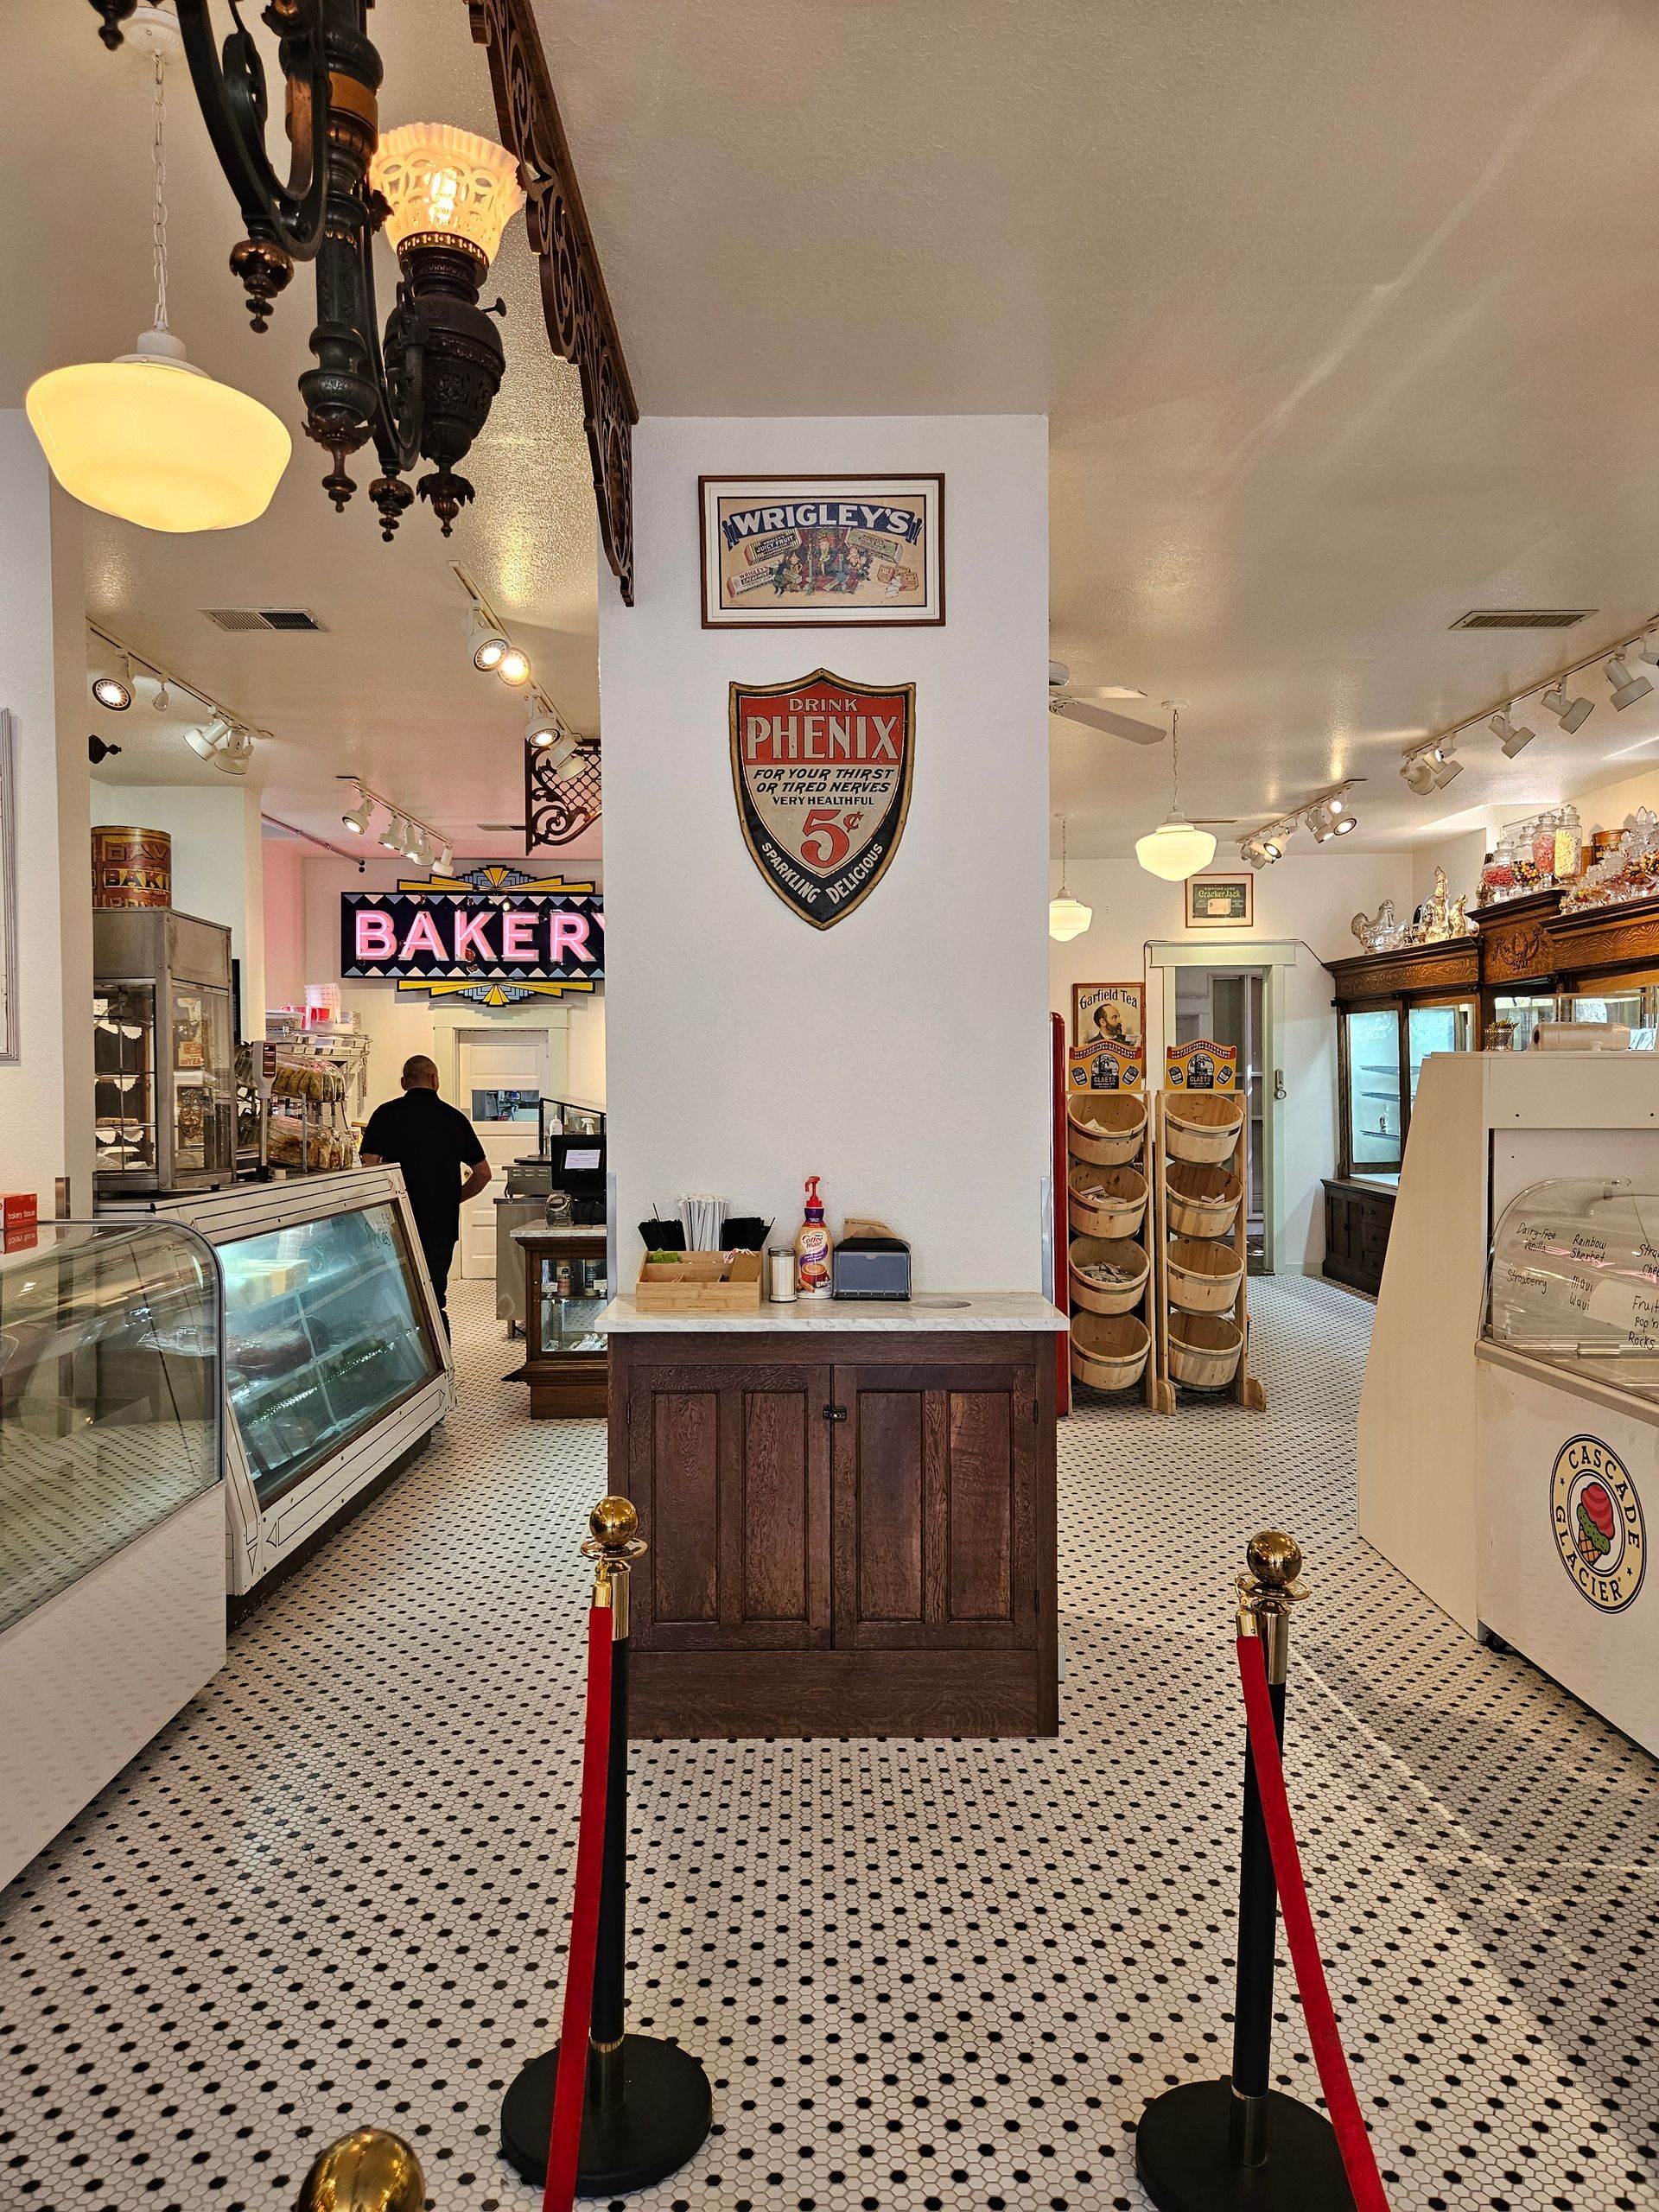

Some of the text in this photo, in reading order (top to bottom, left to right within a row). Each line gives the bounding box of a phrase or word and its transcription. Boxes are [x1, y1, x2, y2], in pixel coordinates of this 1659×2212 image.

[732, 505, 911, 536] WRIGLEY'S
[756, 543, 775, 553] JUICY
[776, 535, 794, 547] FRUIT
[789, 698, 858, 712] DRINK
[746, 715, 901, 760] PHENIX
[753, 768, 895, 781] FOR YOUR THIRST
[756, 782, 891, 794] OR TIRED NERVES
[772, 797, 874, 805] VERY HEALTHFUL
[761, 842, 821, 905] SPARKLING
[825, 842, 883, 905] DELICIOUS
[1080, 988, 1138, 1010] Garfield Tea
[802, 1235, 823, 1244] Coffee
[1516, 1222, 1557, 1241] Dairy-Free
[1572, 1233, 1607, 1249] Rainbow
[1570, 1248, 1605, 1263] Sherbet
[1632, 1295, 1659, 1313] Fruit
[1568, 1445, 1641, 1549] CASCADE
[1555, 1505, 1624, 1603] GLACIER
